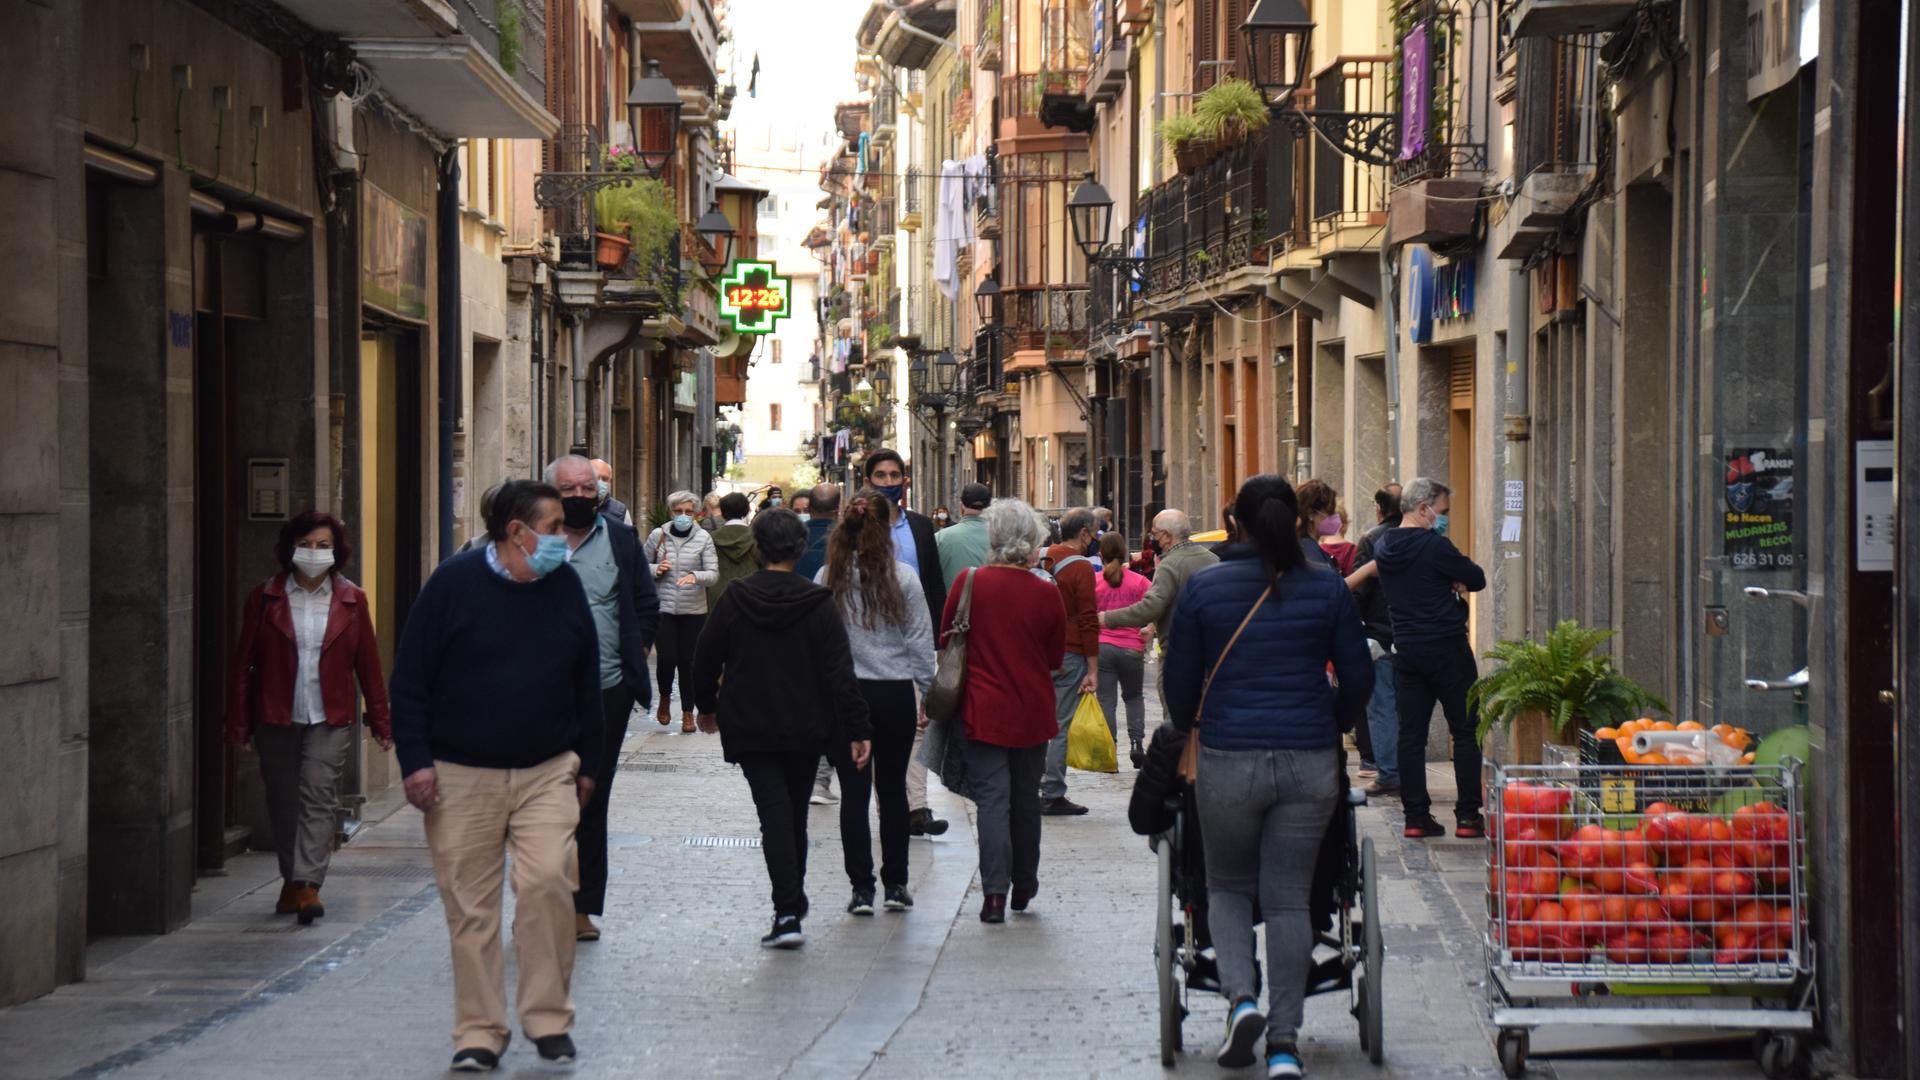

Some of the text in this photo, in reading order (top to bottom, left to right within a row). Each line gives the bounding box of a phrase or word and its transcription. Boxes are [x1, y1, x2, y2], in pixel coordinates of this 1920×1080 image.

[730, 289, 781, 306] 12:26
[1727, 512, 1772, 522] Se Hacen
[1726, 522, 1787, 539] MUDANZAS
[1733, 553, 1793, 565] 626 31 09
